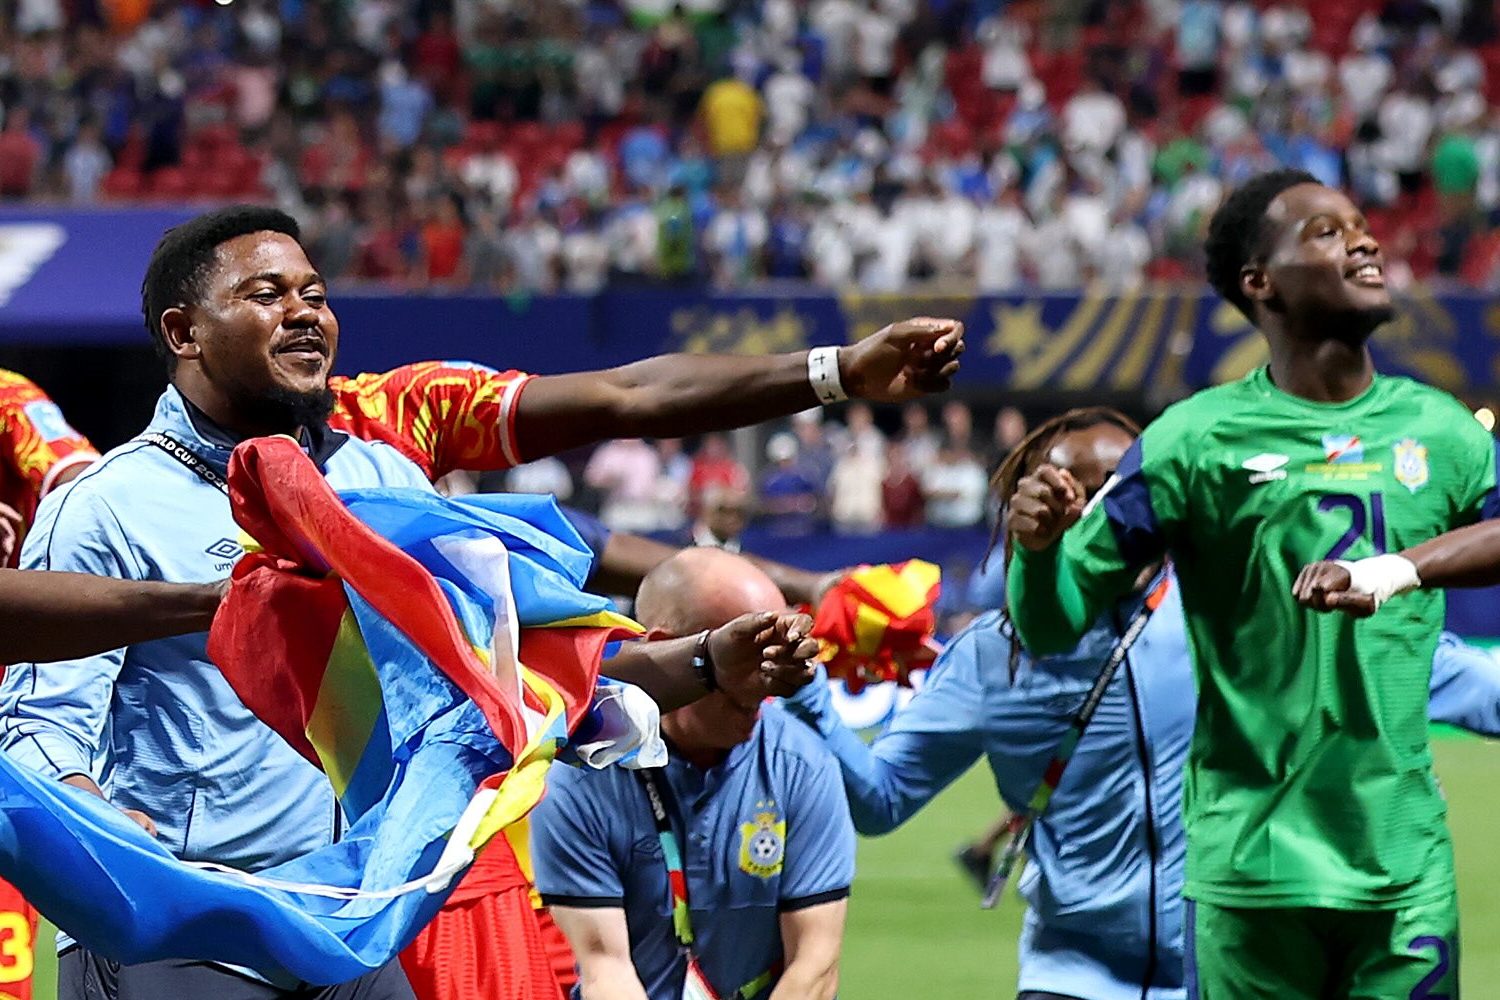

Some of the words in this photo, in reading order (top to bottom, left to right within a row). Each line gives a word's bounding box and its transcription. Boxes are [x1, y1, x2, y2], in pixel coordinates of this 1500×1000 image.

[143, 434, 177, 451] ORLD
[174, 448, 198, 465] CUP
[1317, 491, 1388, 562] 21
